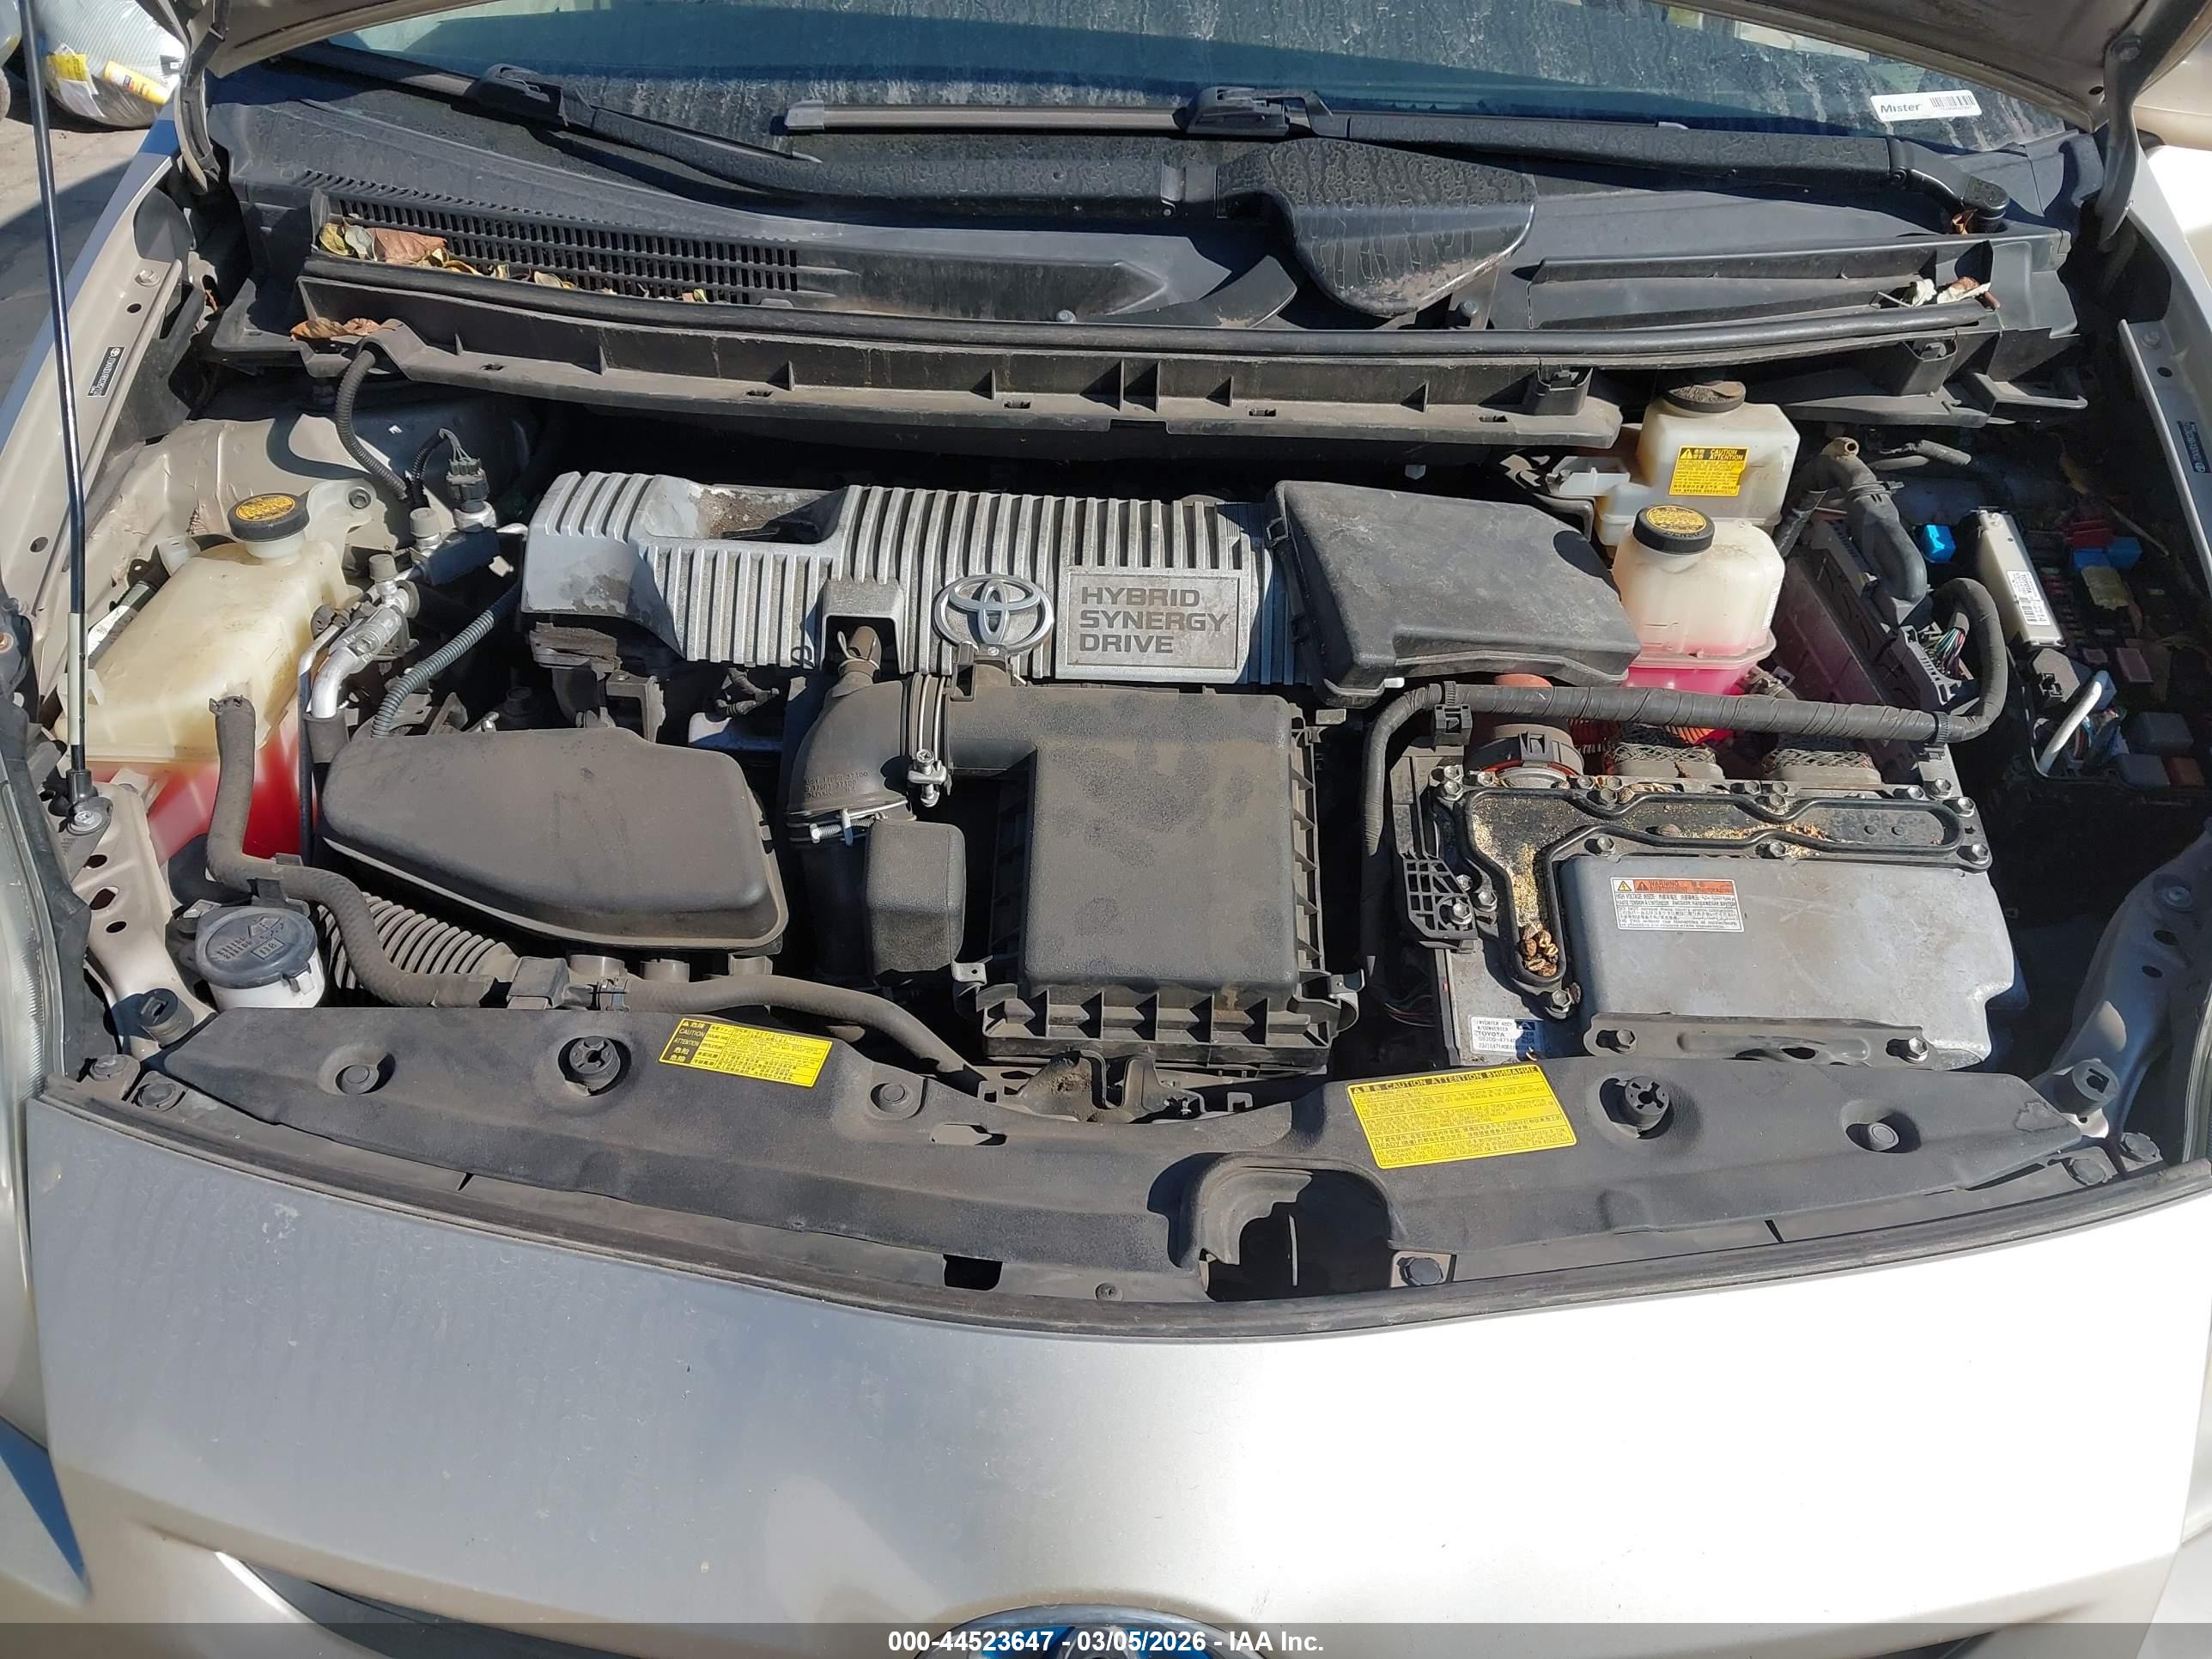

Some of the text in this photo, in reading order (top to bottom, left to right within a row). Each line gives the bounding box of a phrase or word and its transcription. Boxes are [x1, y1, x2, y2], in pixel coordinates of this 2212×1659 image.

[1880, 103, 1921, 113] Mister
[1081, 586, 1200, 607] HYBRID
[1079, 610, 1229, 632] SYNERGY
[1079, 634, 1174, 653] DRIVE
[673, 1037, 700, 1047] ATTENTION
[678, 1029, 705, 1037] CAUTION
[1386, 1079, 1426, 1090] CAUTION
[1431, 1073, 1483, 1085] ATTENTION
[1486, 1066, 1537, 1078] ВНИМАНИЕ
